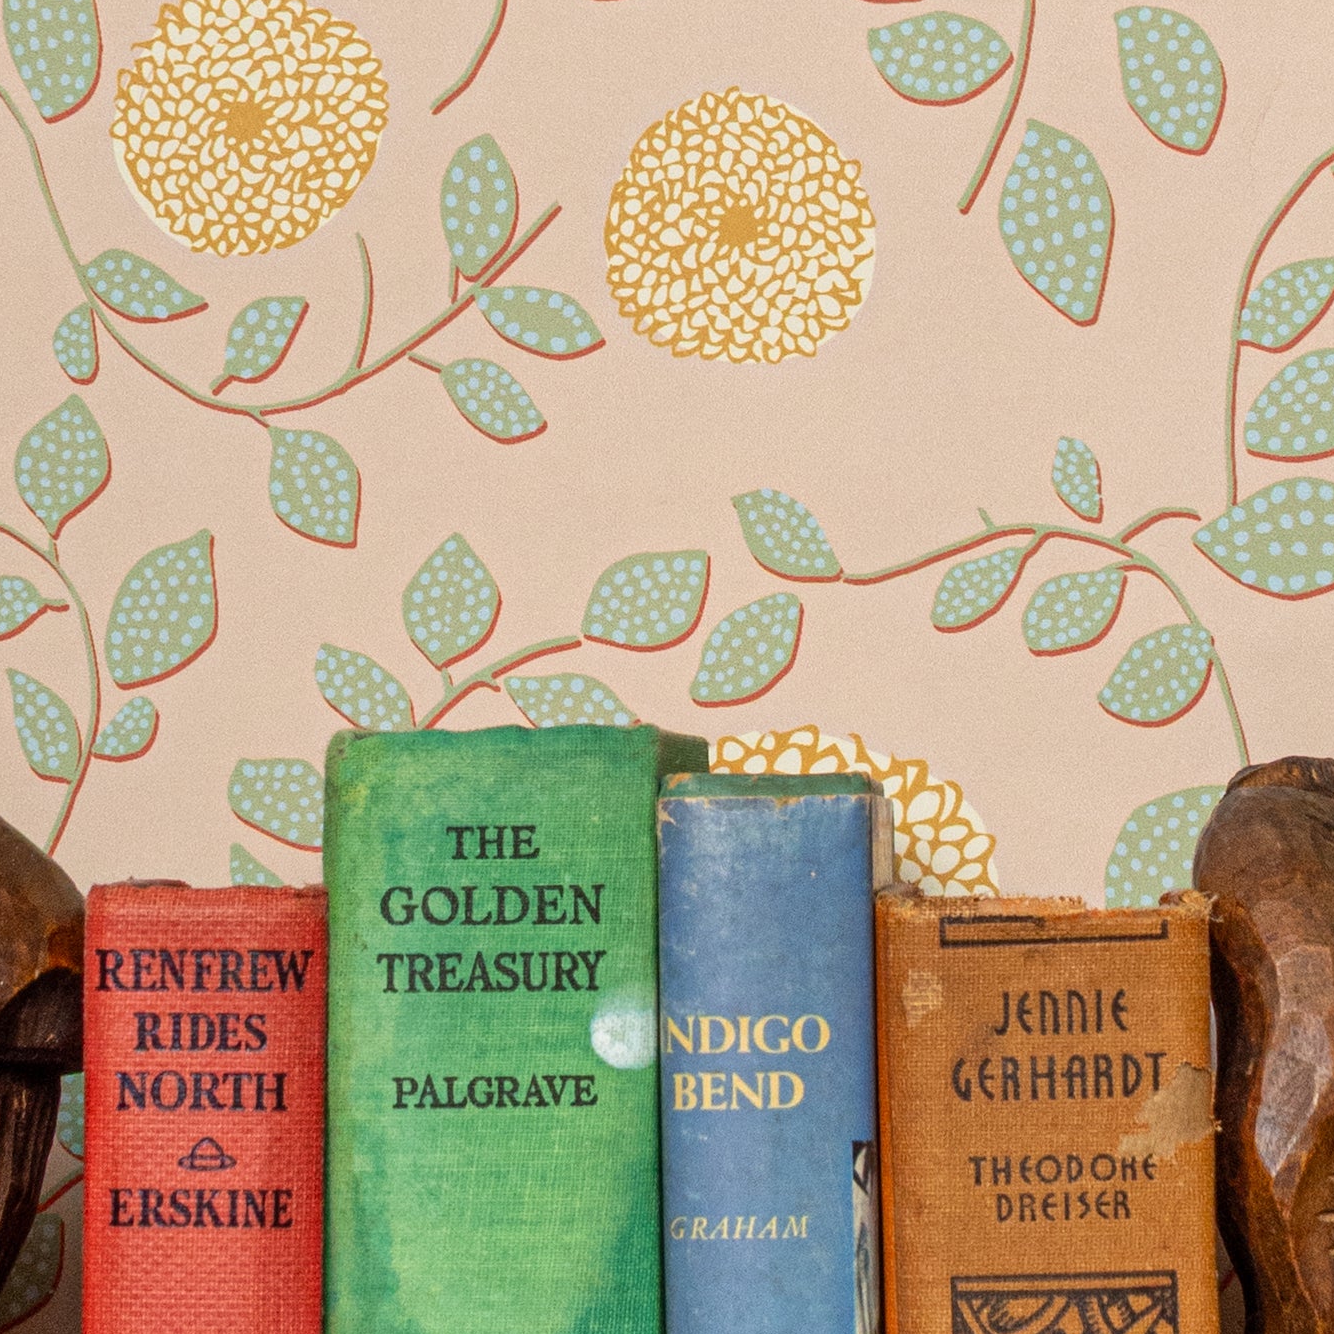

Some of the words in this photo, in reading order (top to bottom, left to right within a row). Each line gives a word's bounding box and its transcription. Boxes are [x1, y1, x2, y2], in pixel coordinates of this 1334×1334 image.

[446, 825, 540, 860] THE
[380, 884, 605, 926] GOLDEN
[95, 949, 314, 992] RENFREW
[376, 950, 607, 994] TREASURY
[133, 1012, 267, 1052] RIDES
[994, 989, 1129, 1035] JENNIE
[665, 1014, 831, 1054] NDIGO
[115, 1070, 288, 1111] NORTH
[392, 1075, 598, 1109] PALGRAVE
[673, 1071, 805, 1110] BEND
[951, 1052, 1167, 1101] GERHARDT
[108, 1189, 293, 1228] ERSKINE
[996, 1190, 1131, 1222] DREISER
[670, 1216, 809, 1240] GRAHAM
